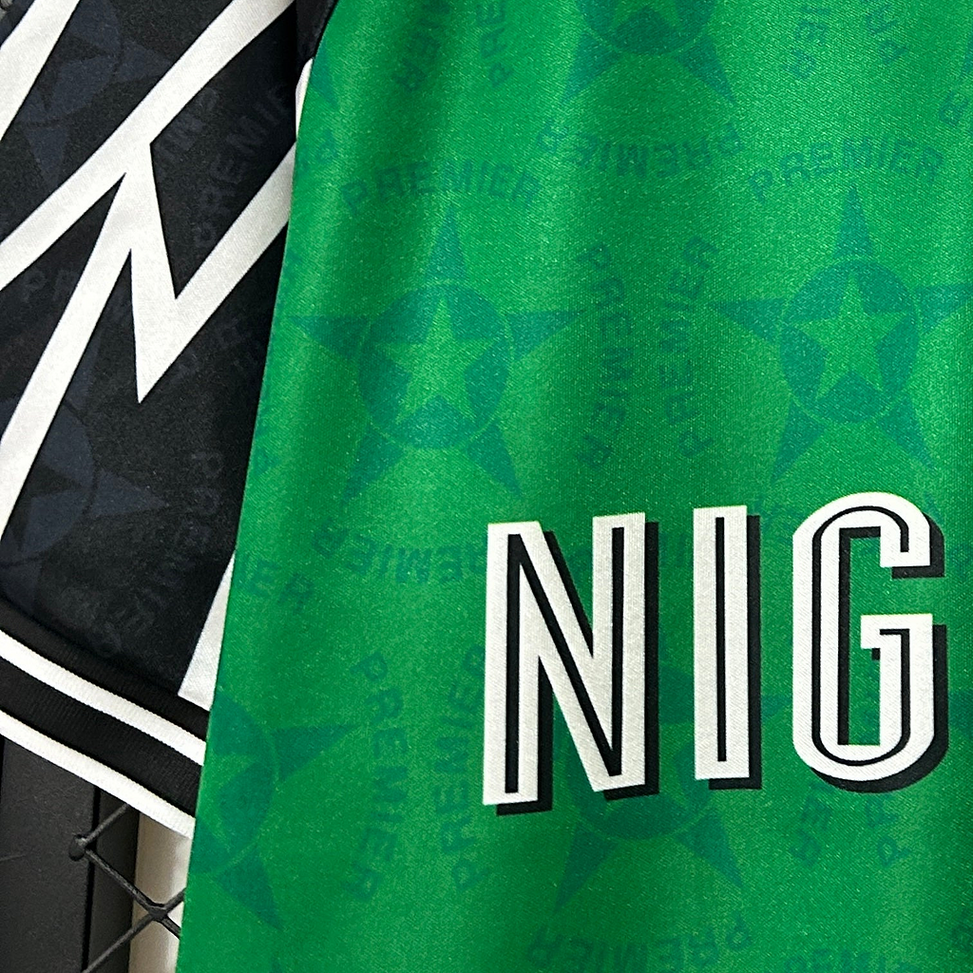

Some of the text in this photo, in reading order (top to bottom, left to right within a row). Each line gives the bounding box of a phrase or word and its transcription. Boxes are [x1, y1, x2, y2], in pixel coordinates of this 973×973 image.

[341, 158, 543, 217] PREMIER
[537, 117, 745, 181] PREMIER
[748, 136, 945, 206] PREMIER
[575, 241, 636, 470] PREMIER
[657, 235, 720, 459] PREMIER
[340, 651, 408, 902] PREMIER
